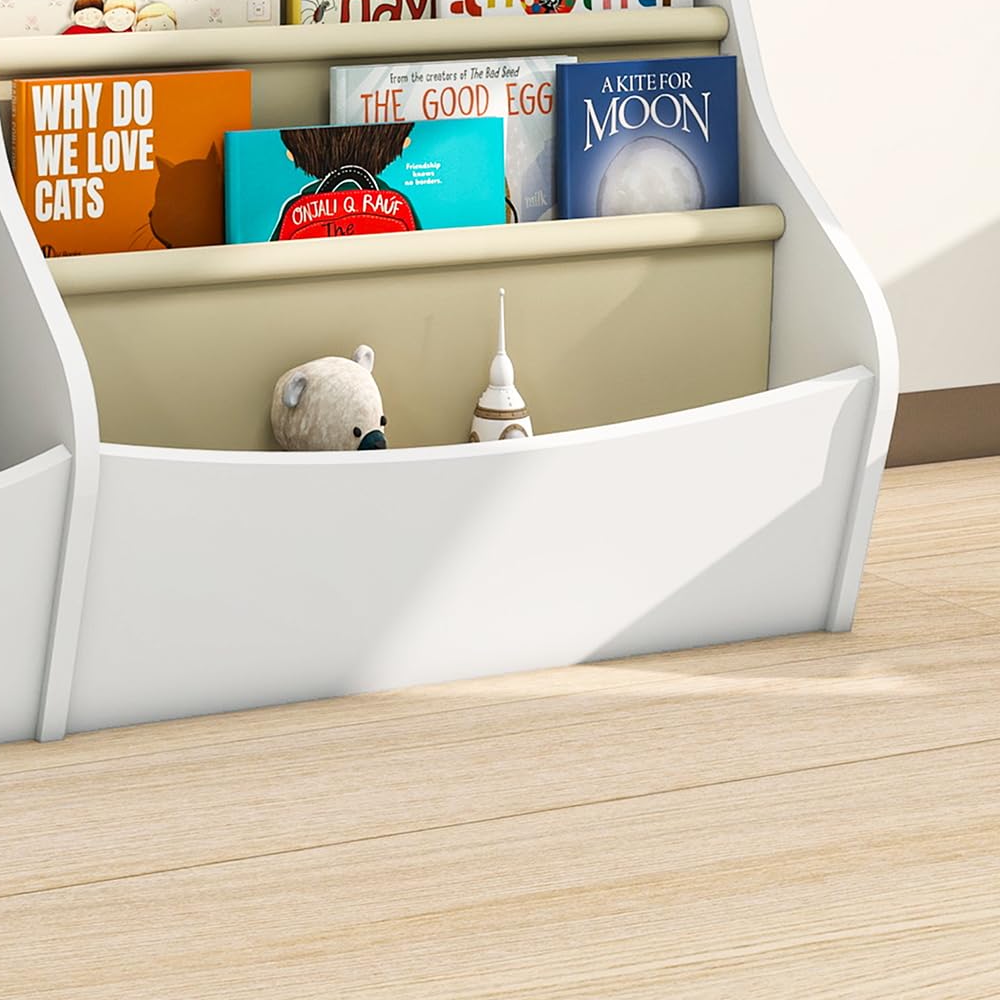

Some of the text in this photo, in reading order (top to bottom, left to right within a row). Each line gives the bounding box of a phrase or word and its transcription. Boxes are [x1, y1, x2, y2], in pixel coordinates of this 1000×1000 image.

[390, 65, 520, 83] From the creators of The Bad Seed
[601, 72, 692, 93] A KITE FOR
[31, 82, 102, 132] WHY
[113, 80, 153, 127] DO
[360, 82, 553, 123] THE GOOD EGG
[583, 92, 711, 151] MOON
[34, 129, 154, 177] WE LOVE
[405, 161, 441, 170] Friendship
[34, 177, 104, 222] CATS
[292, 199, 337, 225] ONJALI
[524, 189, 548, 209] milk
[321, 221, 355, 238] The
